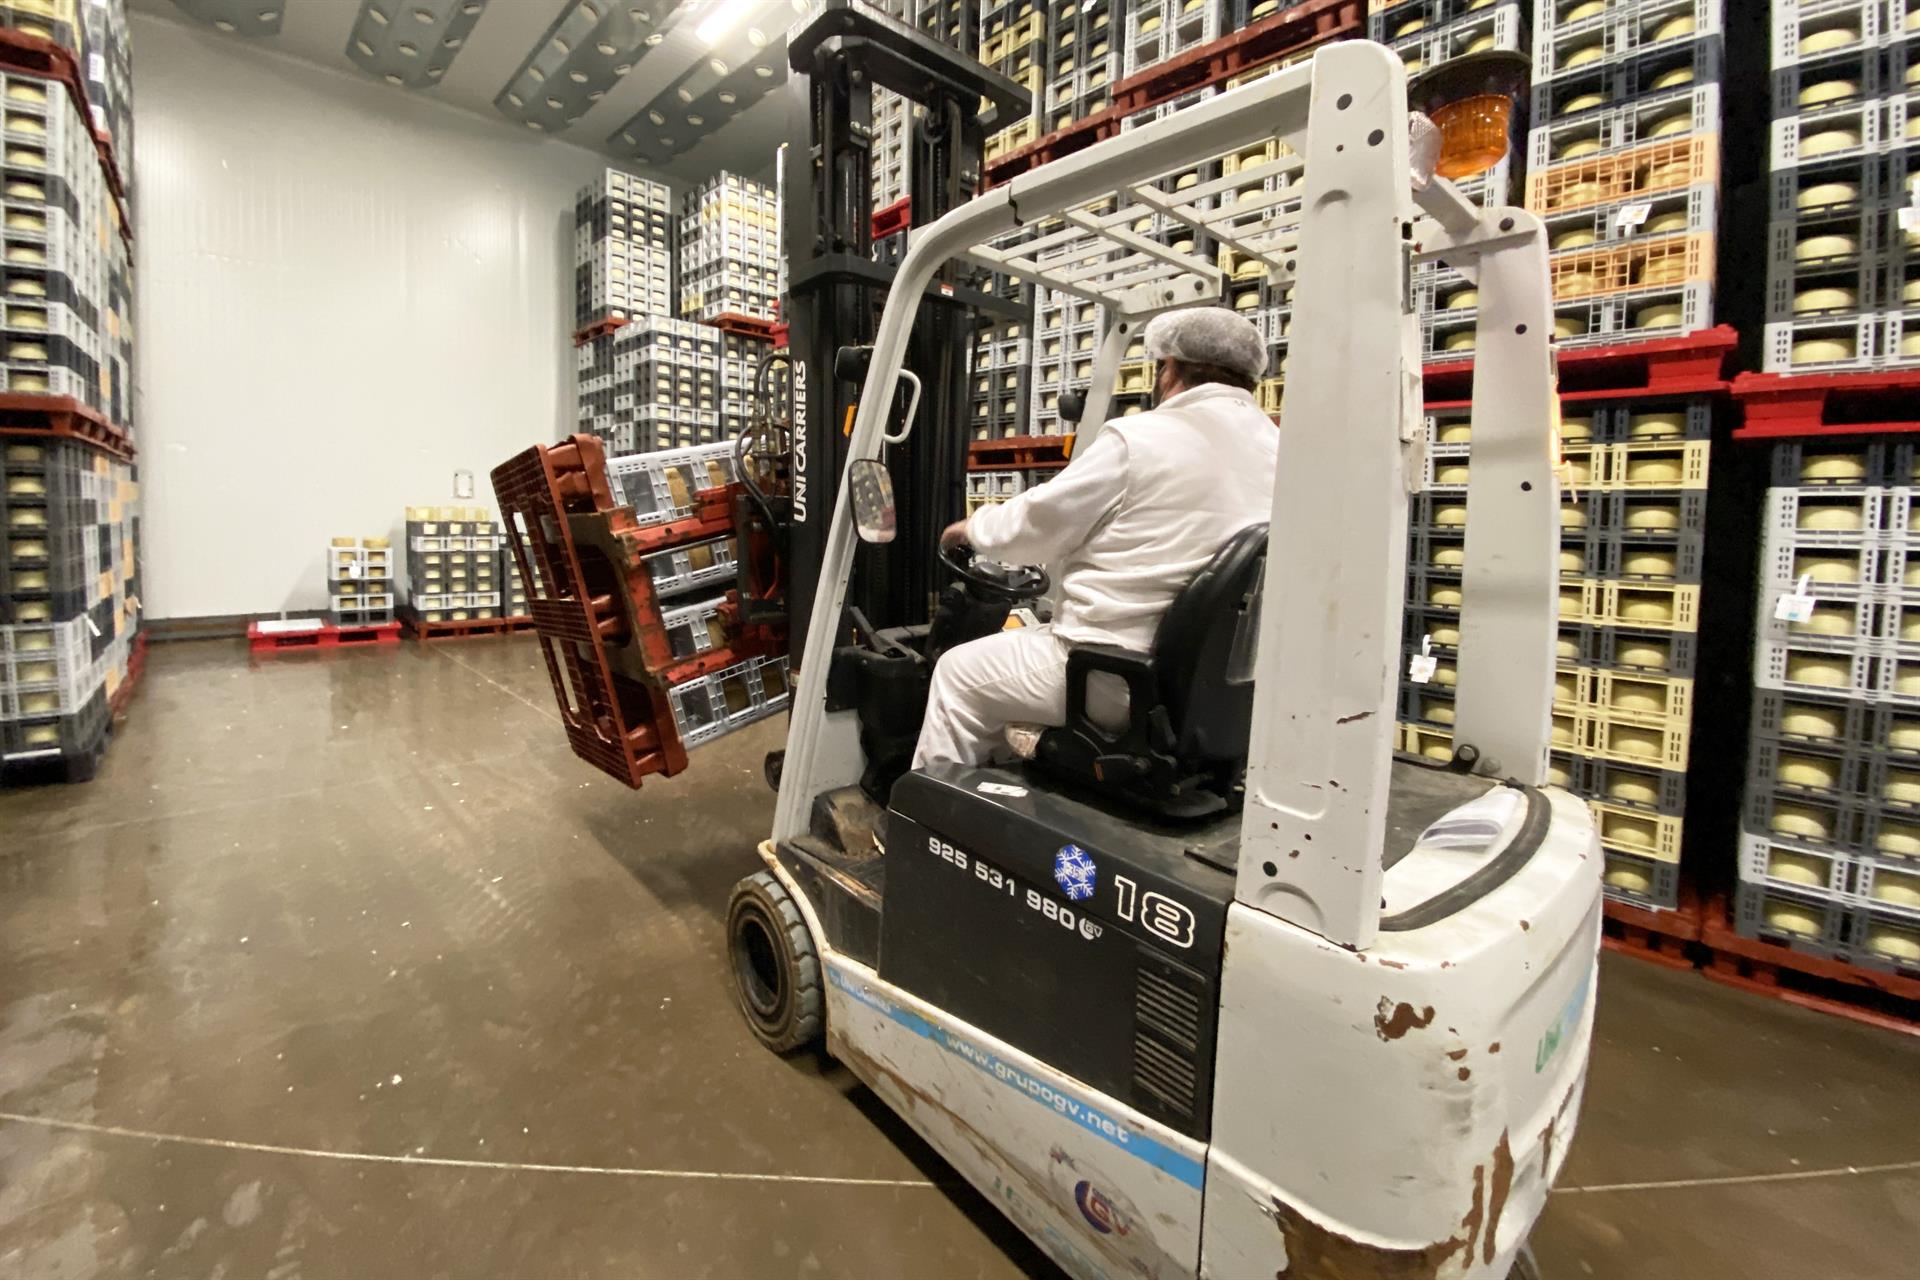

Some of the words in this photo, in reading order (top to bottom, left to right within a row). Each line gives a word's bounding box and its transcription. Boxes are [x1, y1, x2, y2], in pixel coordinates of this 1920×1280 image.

[928, 836, 968, 870] 925
[974, 860, 1016, 897] 531
[1026, 888, 1076, 931] 980
[1114, 874, 1196, 949] 18
[945, 1034, 1129, 1143] www.grupogv.net
